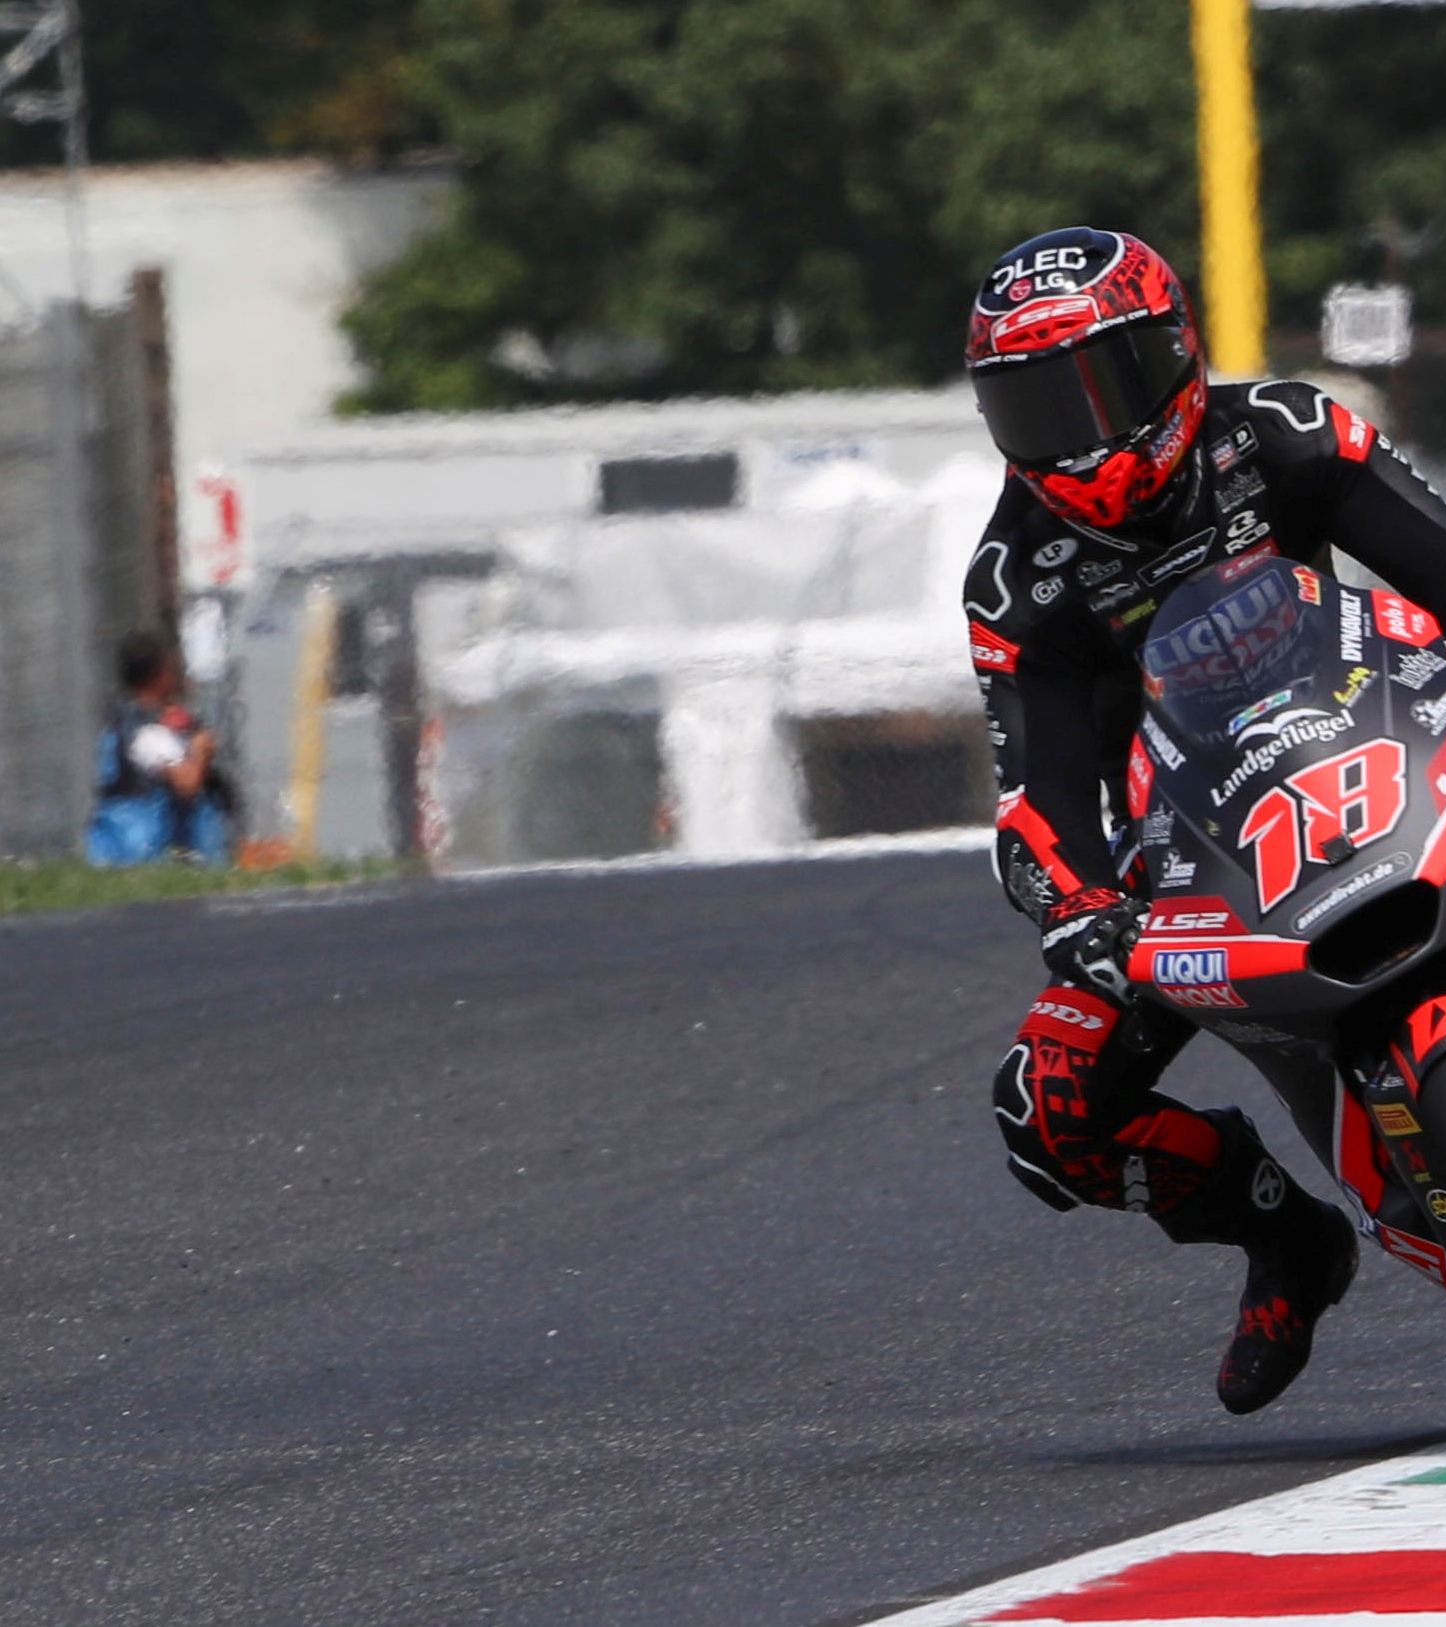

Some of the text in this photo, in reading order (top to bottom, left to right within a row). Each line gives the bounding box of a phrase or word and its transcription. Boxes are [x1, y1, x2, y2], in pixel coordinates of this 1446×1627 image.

[1034, 272, 1065, 292] LG
[1042, 542, 1064, 562] LP
[1209, 709, 1356, 808] Landgeflügel
[1236, 736, 1407, 914] 18
[1150, 911, 1230, 932] LS2
[1155, 952, 1227, 984] LIQUI
